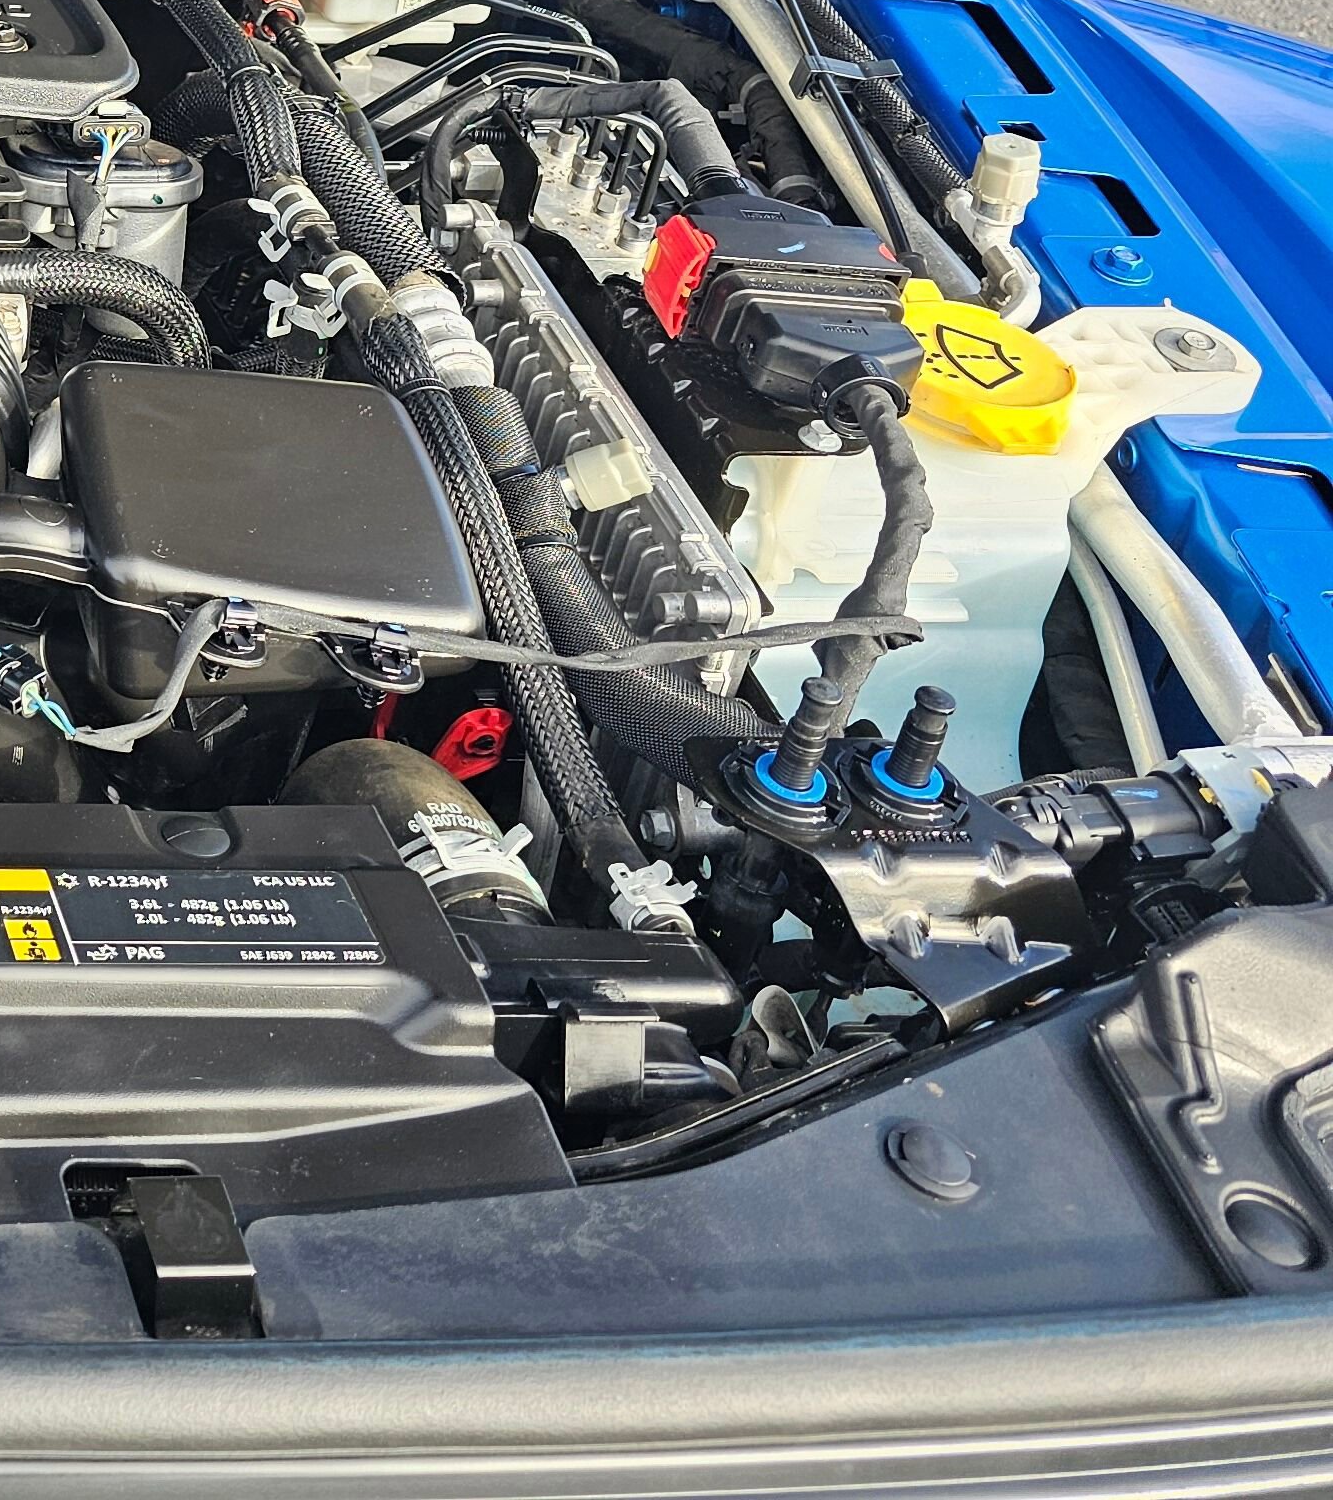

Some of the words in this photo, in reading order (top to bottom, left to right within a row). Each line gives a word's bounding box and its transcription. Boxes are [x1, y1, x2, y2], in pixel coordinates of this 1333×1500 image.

[426, 802, 463, 814] RAD
[407, 811, 493, 834] 6280782AD
[87, 874, 169, 891] R-1234yf
[252, 875, 283, 887] FCA
[283, 875, 307, 887] US
[307, 876, 336, 887] LLC
[128, 898, 163, 911] 3.6L
[180, 898, 219, 913] 482g
[134, 913, 169, 925] 2.0L
[186, 913, 226, 927] 482g
[124, 945, 166, 960] PAG
[240, 950, 265, 961] SAE
